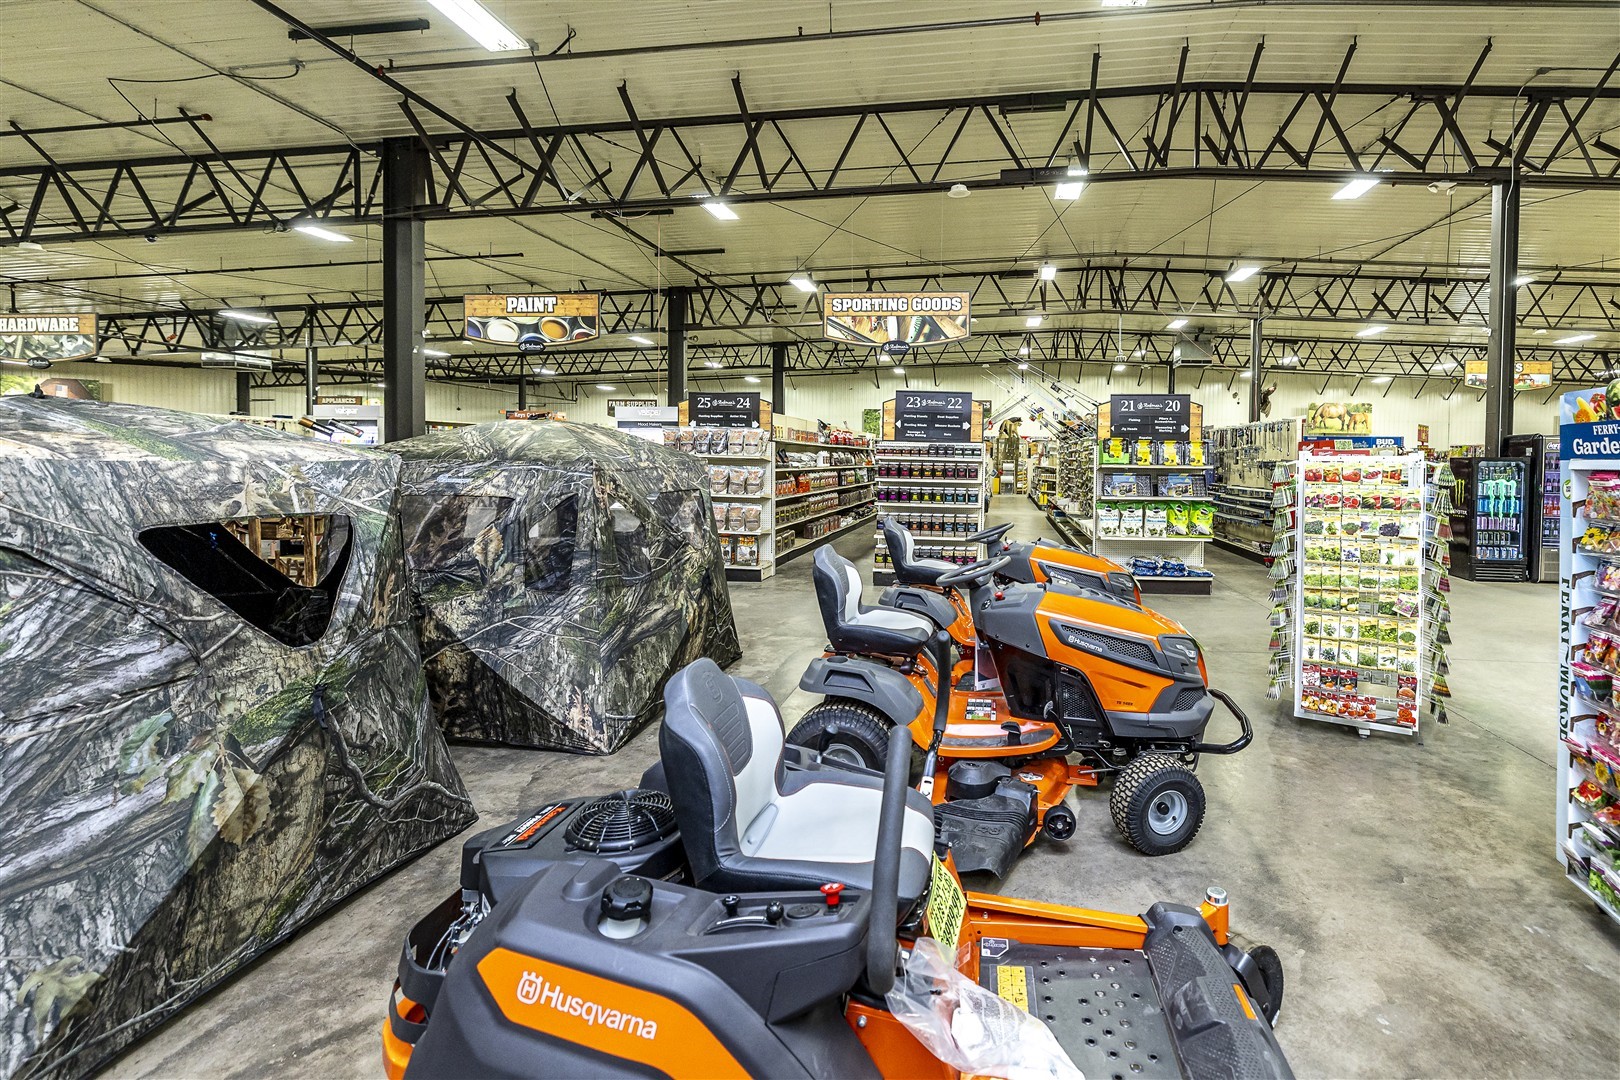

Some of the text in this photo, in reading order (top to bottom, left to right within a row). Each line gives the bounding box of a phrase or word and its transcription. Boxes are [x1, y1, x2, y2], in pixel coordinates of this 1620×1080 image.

[506, 296, 556, 313] PAINT
[832, 297, 962, 312] SPORTING GOODS
[0, 317, 79, 332] HARDWARE
[697, 397, 711, 408] 25
[736, 397, 751, 408] 24
[906, 396, 921, 408] 23
[947, 397, 963, 409] 22
[1120, 400, 1135, 412] 21
[1165, 400, 1181, 412] 20
[1572, 437, 1620, 455] Garde
[1073, 637, 1103, 652] Husqvarna
[539, 981, 658, 1040] Husqvarna
